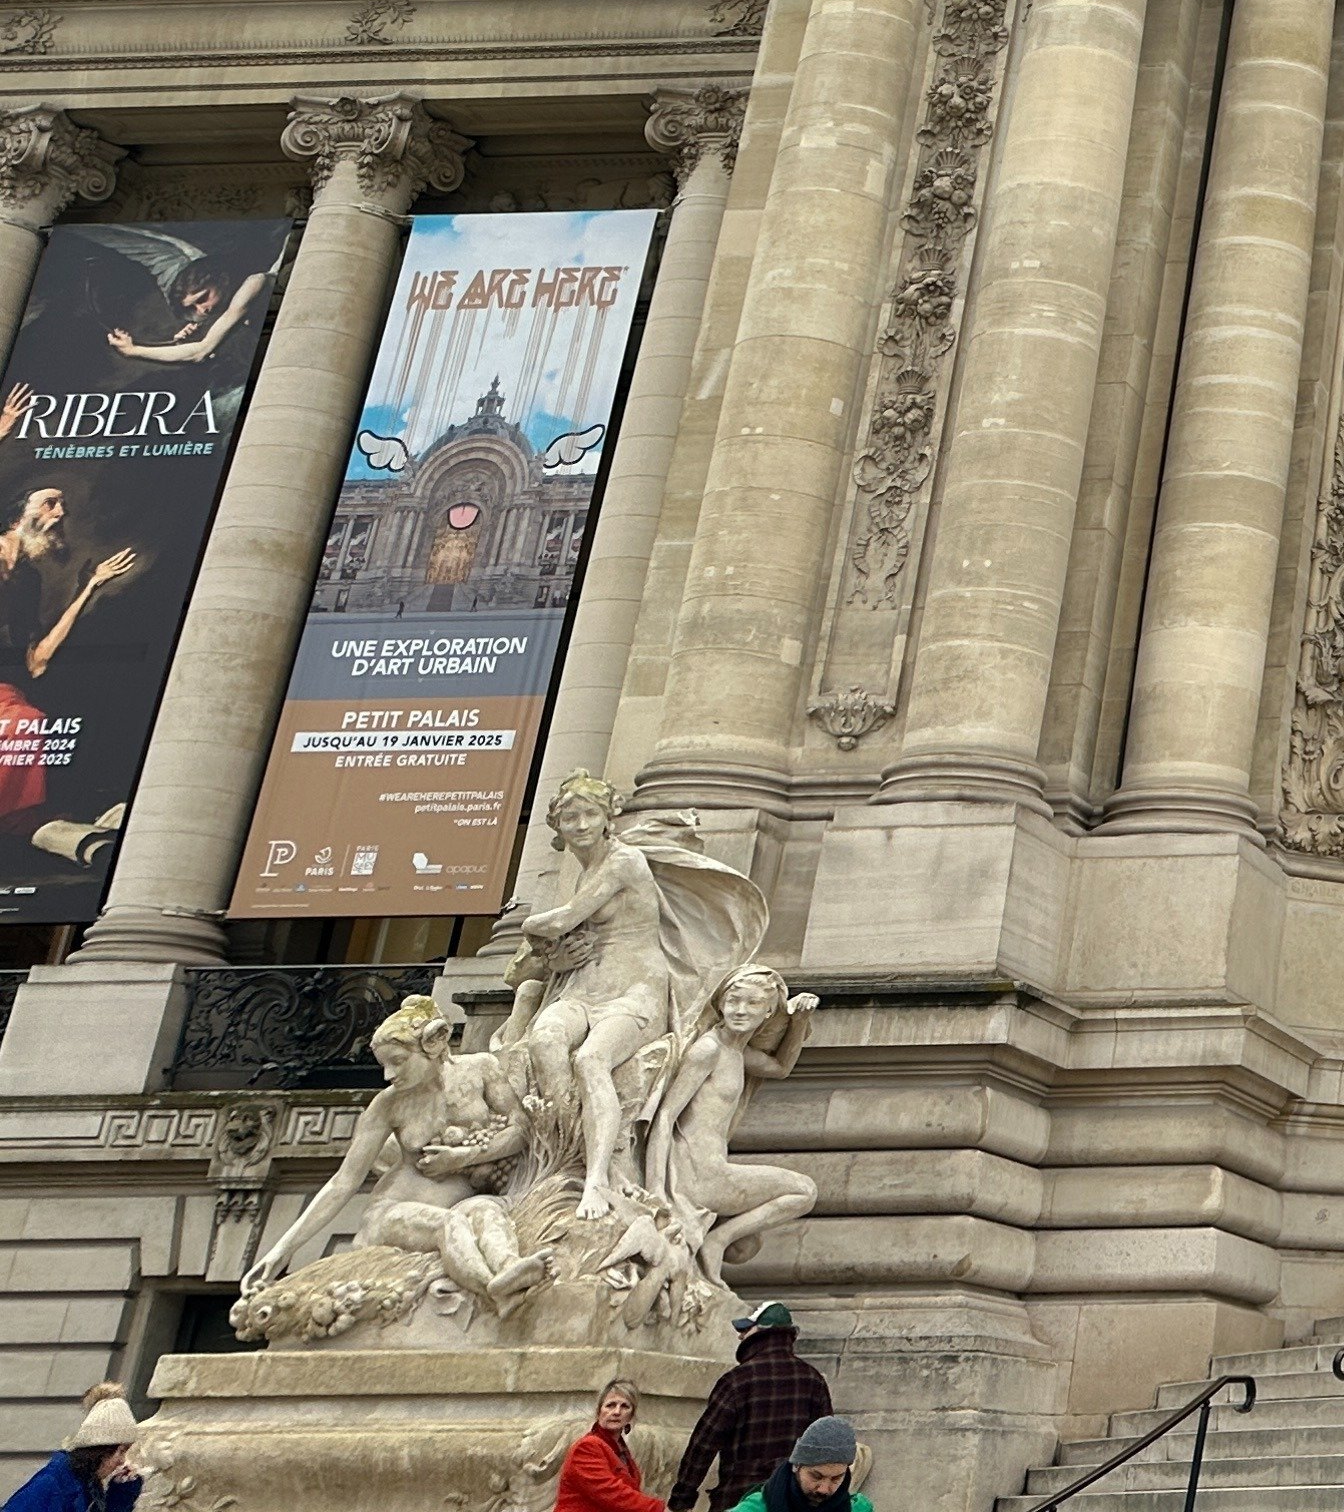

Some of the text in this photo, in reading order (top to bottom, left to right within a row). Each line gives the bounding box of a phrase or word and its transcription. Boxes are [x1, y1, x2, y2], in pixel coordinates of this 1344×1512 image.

[407, 270, 459, 311] WE
[456, 269, 532, 310] ARE
[15, 389, 220, 439] RIBERA
[34, 441, 215, 460] TÉNÈBRES ET LUMIÈRE
[331, 637, 528, 657] UNE EXPLORATION
[351, 656, 498, 676] D'ART URBAIN
[14, 717, 83, 735] PALAIS
[341, 709, 481, 729] PETIT PALAIS
[0, 738, 77, 752] MBRE 2024
[302, 734, 503, 750] JUSQU'AU 19 JANVIER 2025
[38, 753, 72, 766] 2025
[335, 752, 467, 768] ENTRÉE GRATUITE
[379, 790, 504, 802] #WEAREHEREPETITPALAIS
[414, 801, 502, 814] petitpalais.paris.fr
[305, 867, 335, 876] PARIS
